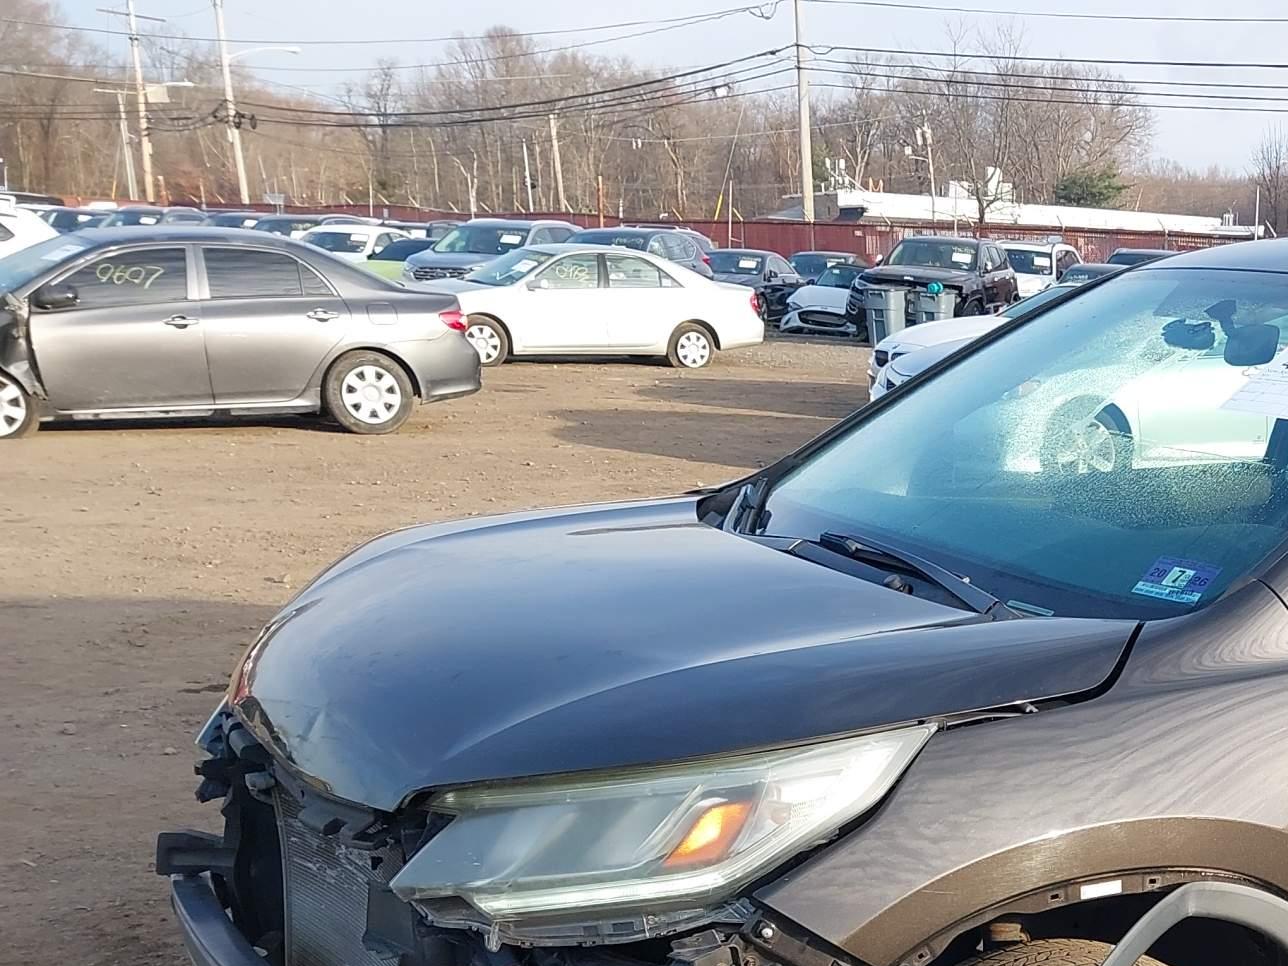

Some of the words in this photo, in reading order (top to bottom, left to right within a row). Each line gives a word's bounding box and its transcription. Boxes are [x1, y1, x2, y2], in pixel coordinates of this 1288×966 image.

[1150, 567, 1167, 578] 20
[1171, 569, 1185, 584] 7
[1192, 575, 1209, 587] 26
